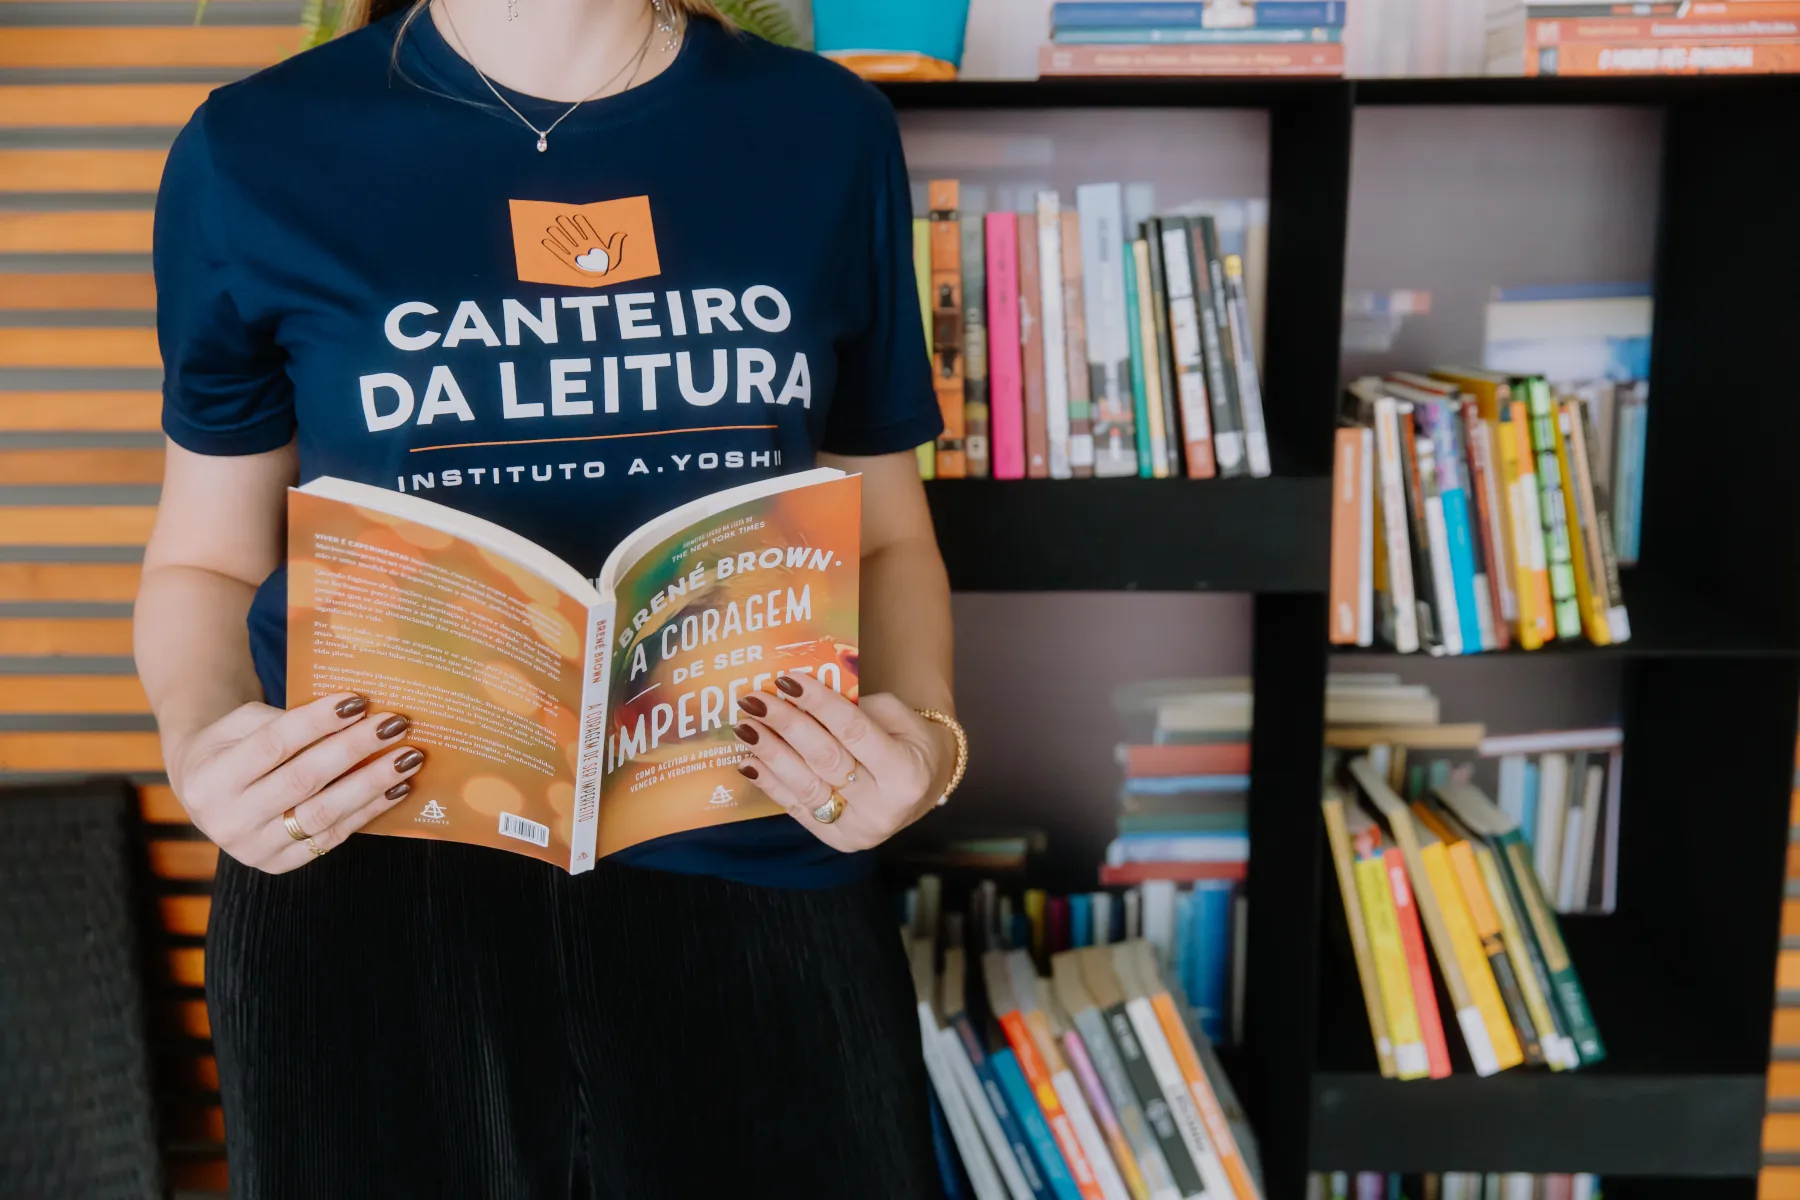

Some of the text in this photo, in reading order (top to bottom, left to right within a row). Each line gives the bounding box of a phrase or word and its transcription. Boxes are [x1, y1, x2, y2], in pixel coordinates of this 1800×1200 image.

[384, 284, 792, 351] CANTEIRO
[359, 347, 812, 432] DA LEITURA
[397, 461, 606, 493] INSTITUTO
[671, 521, 765, 563] THE NEW YORK TIMES
[731, 518, 745, 529] LISTA
[618, 561, 707, 649] BRENÉ
[592, 619, 609, 684] BRENÉ BROWN
[630, 583, 812, 681] A CORAGEM
[672, 645, 763, 685] DE SER
[578, 703, 603, 823] A CORAGEM DE SER IMPERFEITO
[630, 776, 657, 793] VENCER
[659, 773, 665, 782] A
[667, 762, 707, 778] VERGONHA
[709, 759, 714, 768] E
[716, 755, 742, 767] OUSAR
[635, 765, 656, 781] COMO
[657, 753, 688, 771] ACEITAR
